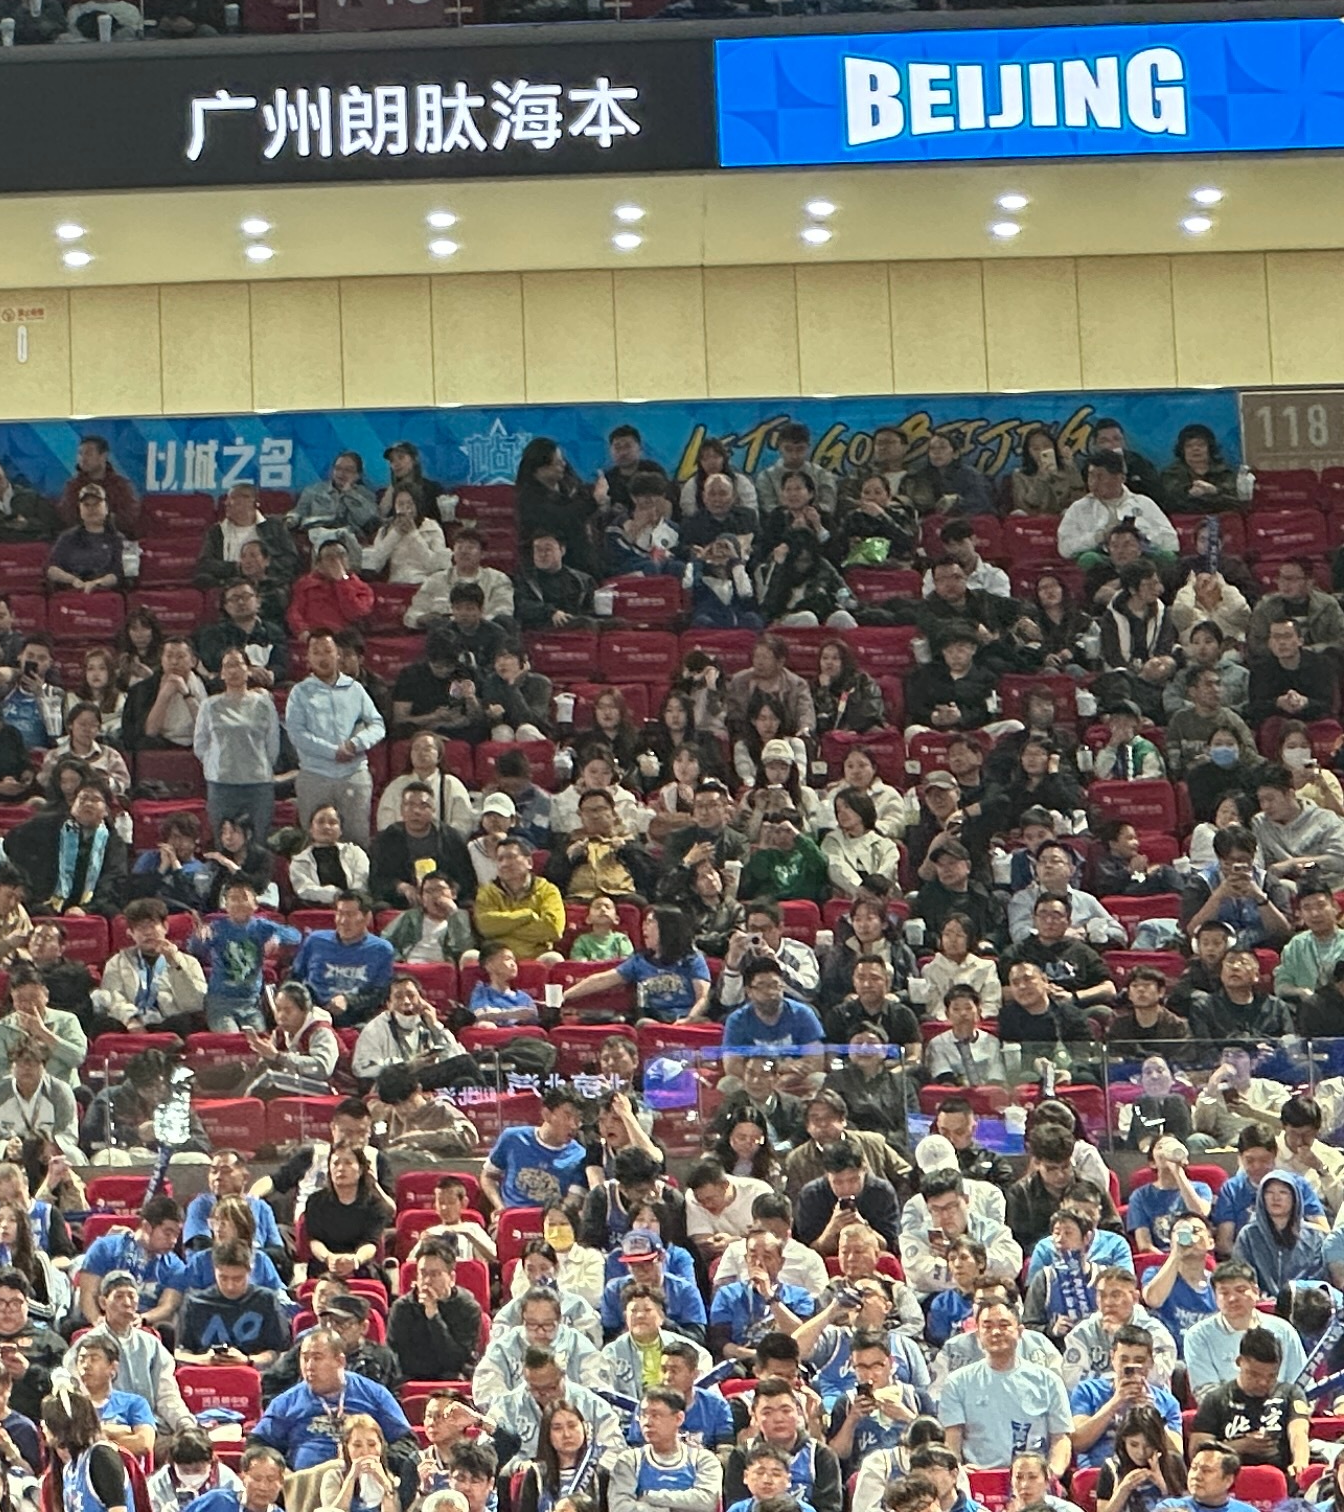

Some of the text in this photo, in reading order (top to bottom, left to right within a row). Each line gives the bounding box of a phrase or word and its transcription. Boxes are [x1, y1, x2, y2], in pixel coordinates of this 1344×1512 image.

[185, 76, 642, 162] 广州朗肽海本
[844, 47, 1188, 147] BEIJING
[1255, 404, 1329, 448] 118
[146, 437, 294, 491] 以城之名
